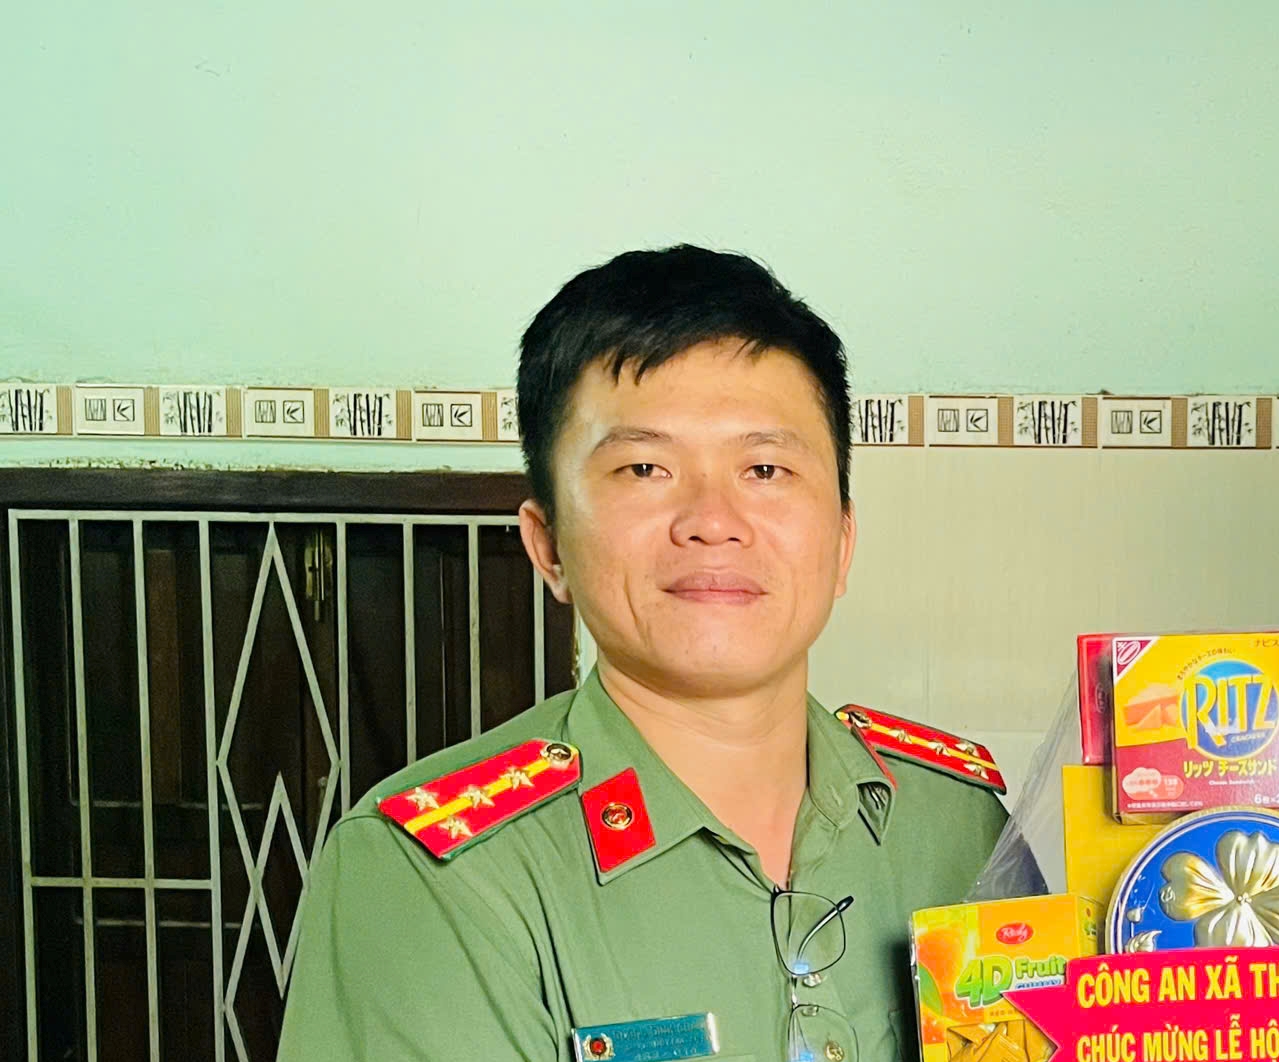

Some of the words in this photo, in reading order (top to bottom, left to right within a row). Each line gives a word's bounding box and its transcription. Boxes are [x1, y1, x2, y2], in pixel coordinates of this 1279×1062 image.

[1183, 674, 1276, 750] RITZ
[956, 955, 1013, 1007] 4D
[1014, 955, 1066, 979] Fruit
[1077, 963, 1150, 1008] CÔNG
[1158, 965, 1196, 1002] AN
[1205, 955, 1242, 1000] XÃ
[1143, 1023, 1208, 1062] MỪNG
[1215, 1013, 1242, 1060] LỄ
